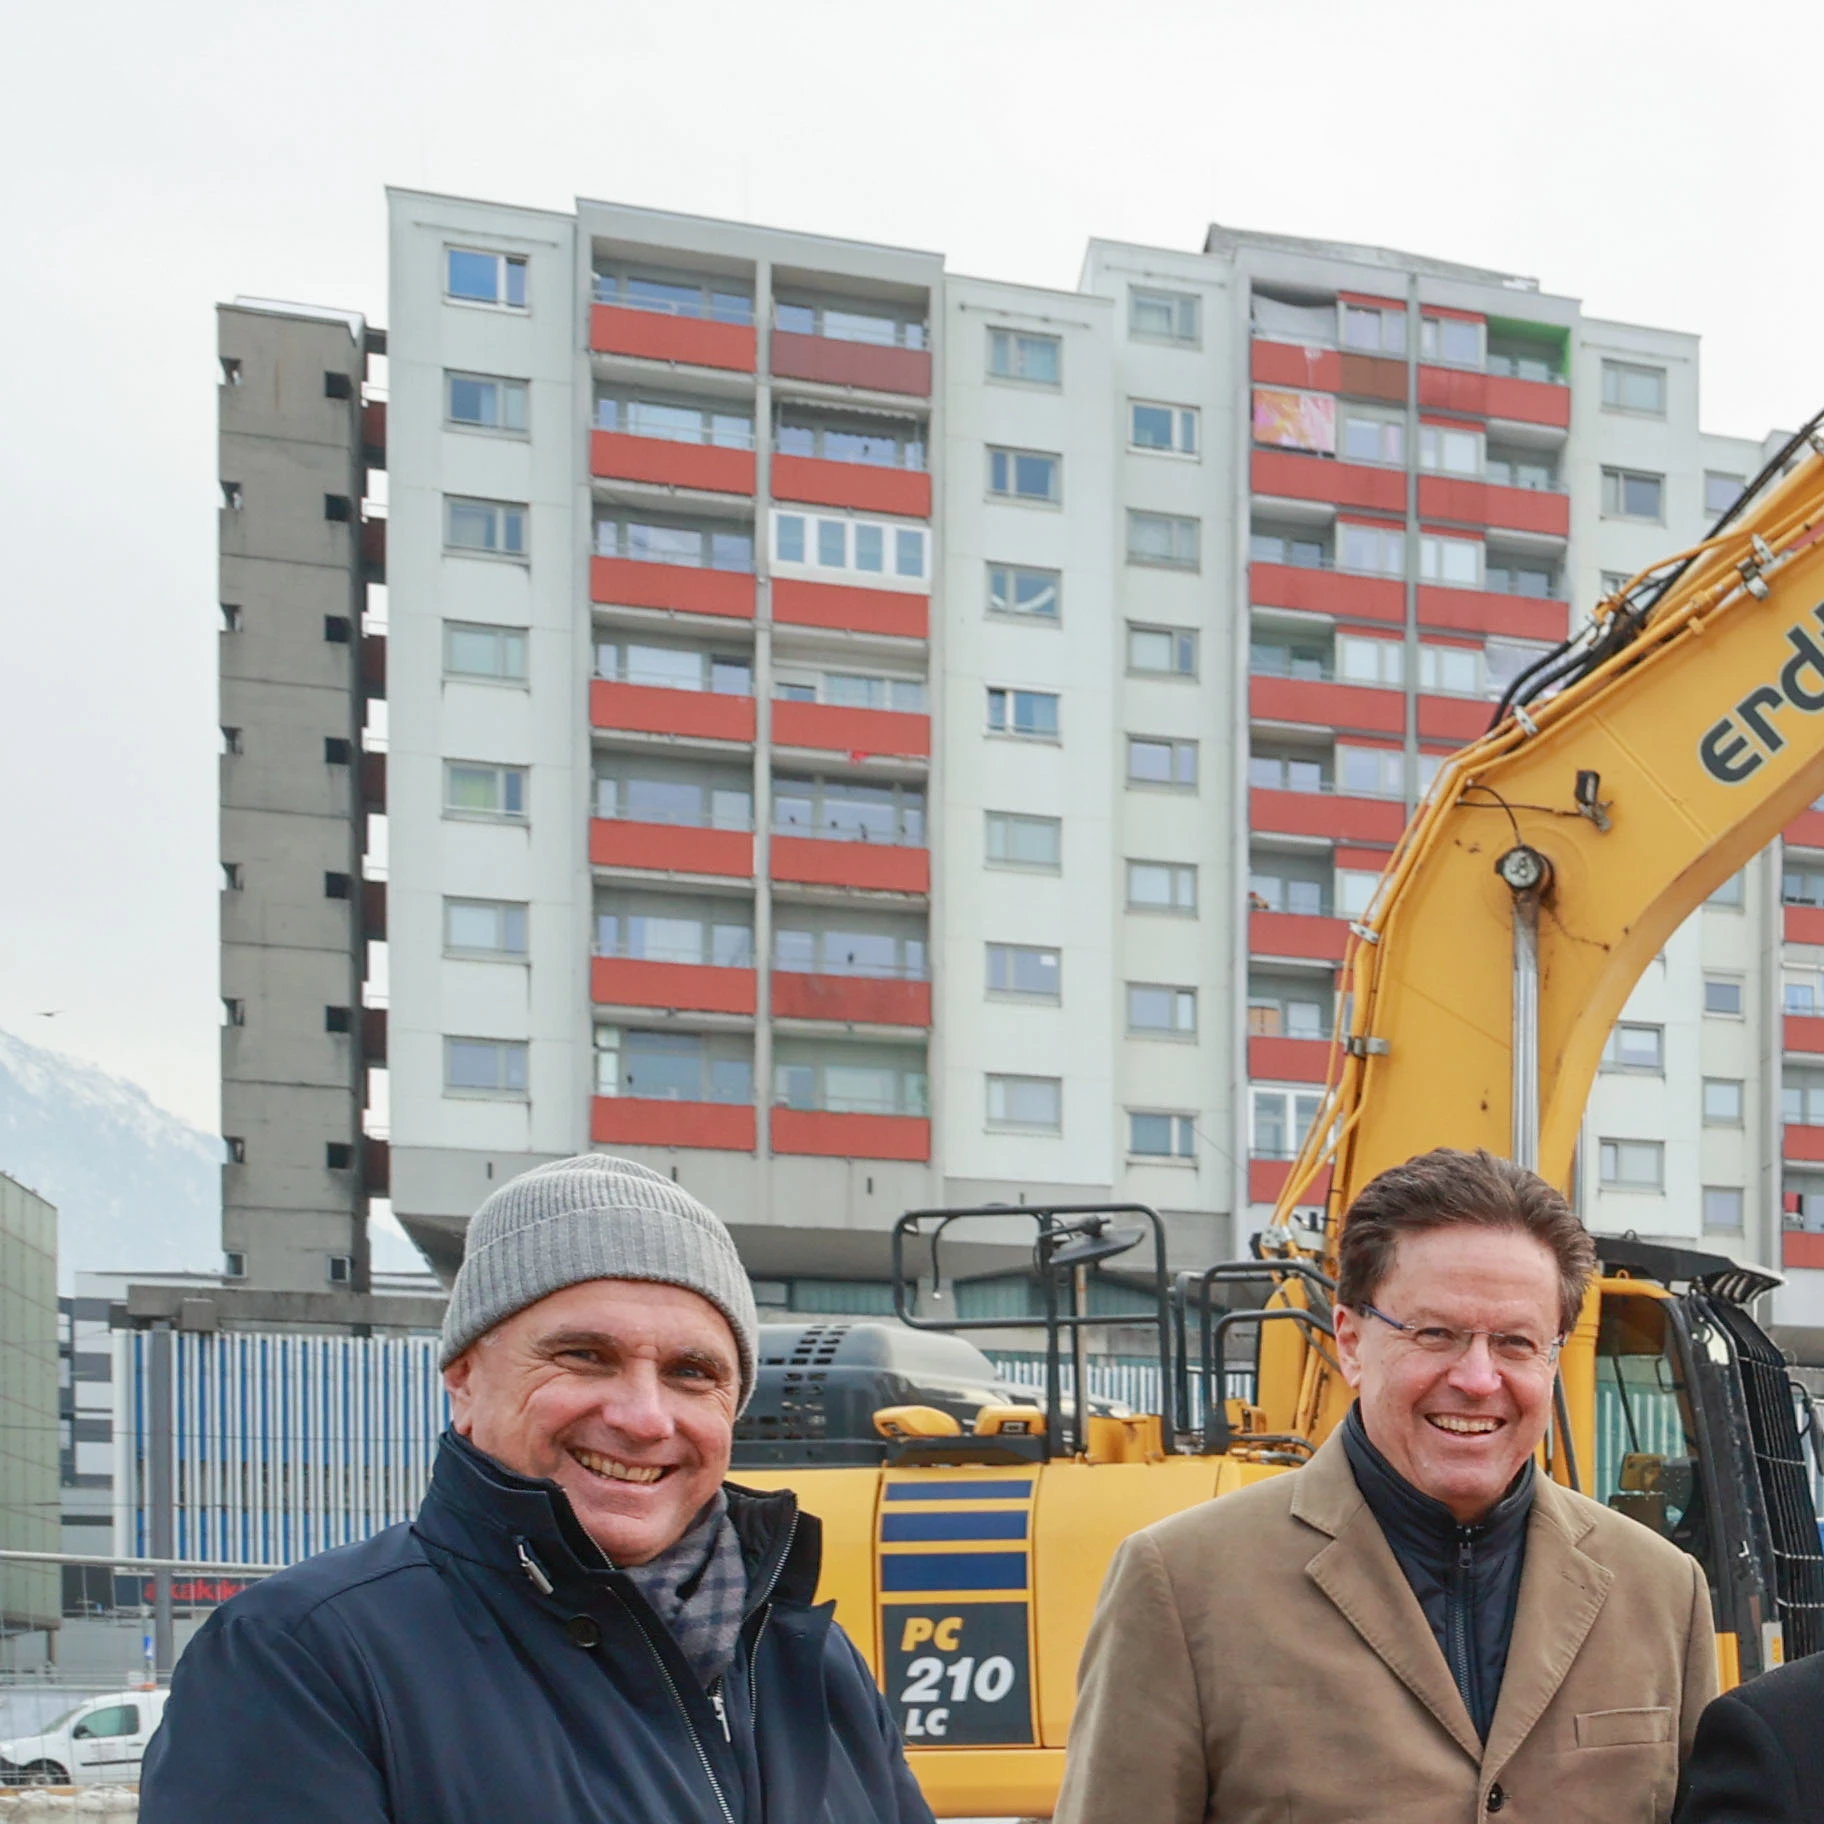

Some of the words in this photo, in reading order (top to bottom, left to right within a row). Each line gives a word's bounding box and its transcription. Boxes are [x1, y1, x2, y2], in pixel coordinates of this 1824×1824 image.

[901, 1617, 964, 1652] PC
[900, 1655, 1015, 1703] 210
[905, 1708, 949, 1736] LC
